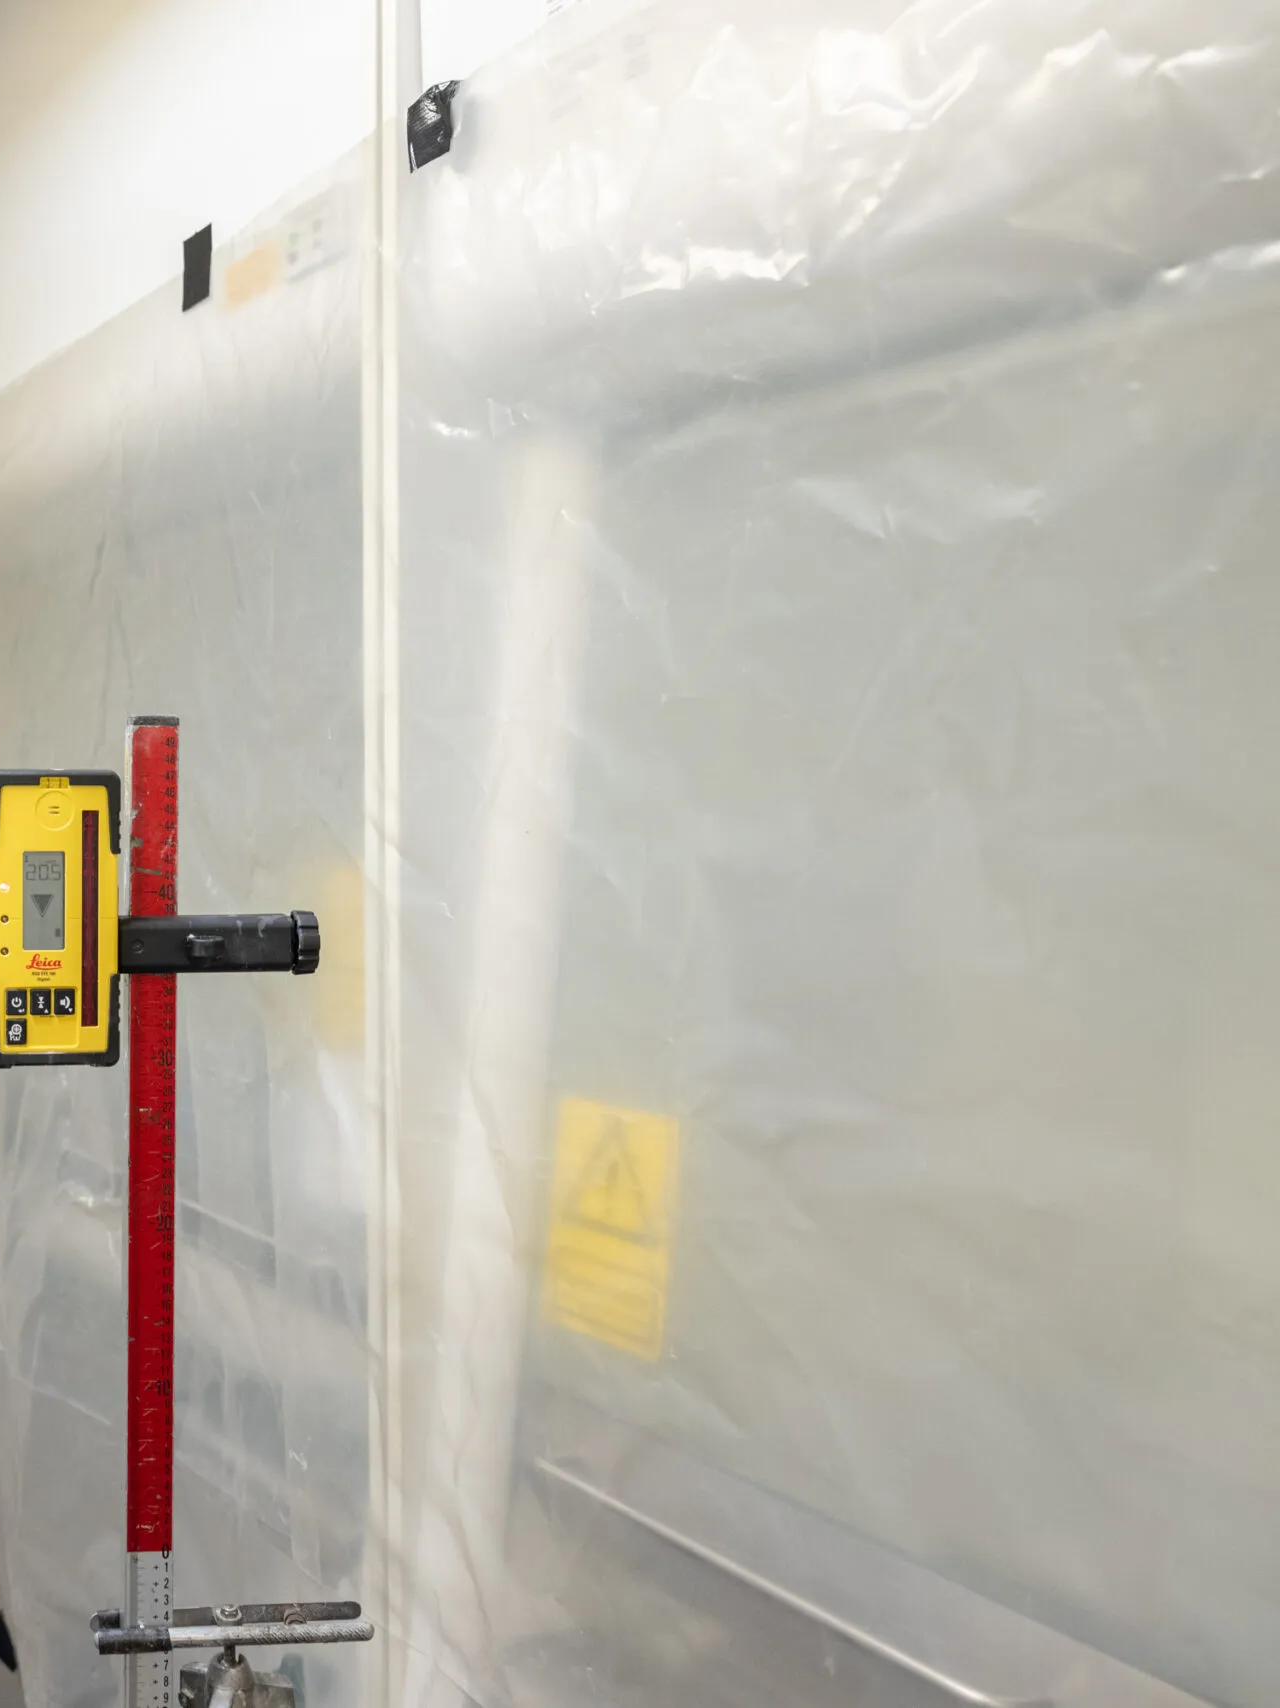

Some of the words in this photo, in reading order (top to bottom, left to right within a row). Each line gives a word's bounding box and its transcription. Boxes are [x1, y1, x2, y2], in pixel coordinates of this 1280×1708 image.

[158, 883, 175, 901] 40
[26, 953, 63, 971] Leica
[157, 1050, 173, 1066] 30
[157, 1214, 172, 1232] 20
[157, 1379, 171, 1396] 10
